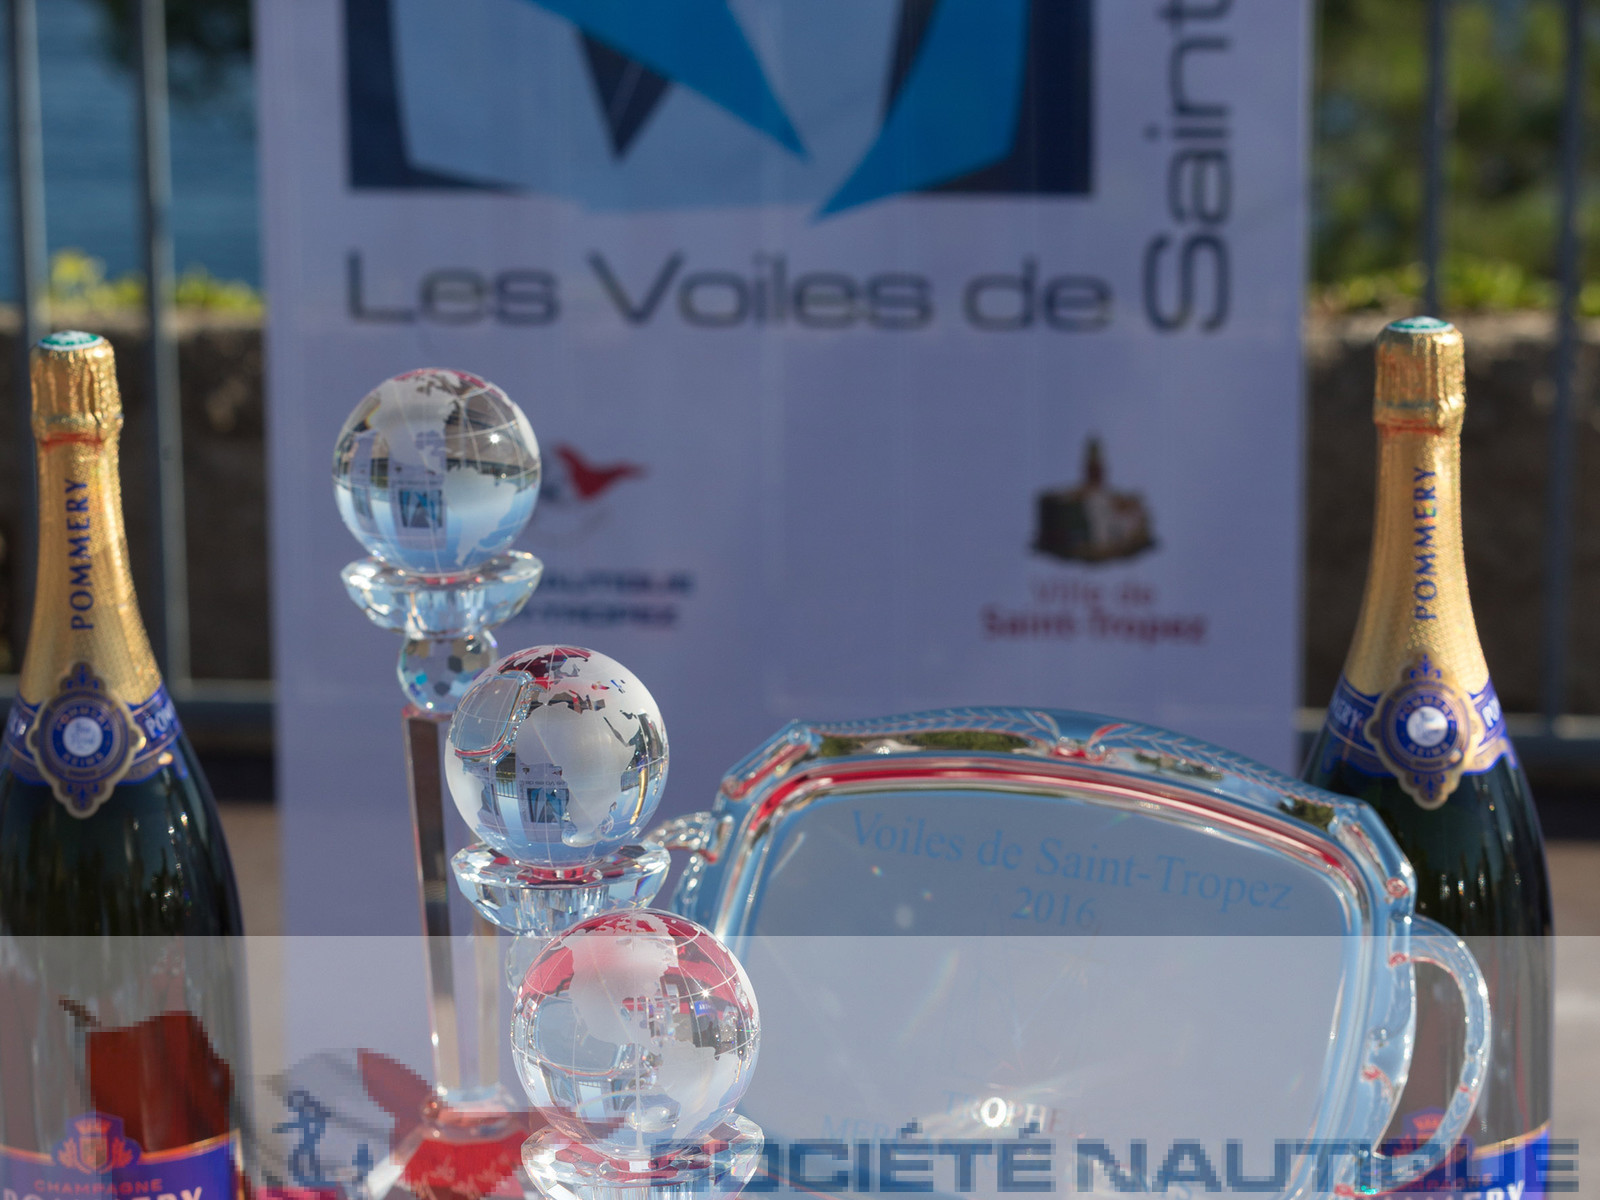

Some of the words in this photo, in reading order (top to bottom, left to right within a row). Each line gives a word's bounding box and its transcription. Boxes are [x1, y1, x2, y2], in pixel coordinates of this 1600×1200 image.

[1142, 0, 1232, 334] Saint
[345, 250, 560, 327] Les
[587, 252, 934, 330] Voiles
[962, 257, 1113, 333] de
[70, 478, 89, 631] POMMERY
[1413, 466, 1437, 622] POMMERY
[850, 808, 965, 863] Voiles
[976, 829, 1023, 870] de
[1035, 835, 1294, 915] Saint-Tropez
[1010, 885, 1097, 930] 2016
[33, 1178, 164, 1195] CHAMPAGNE
